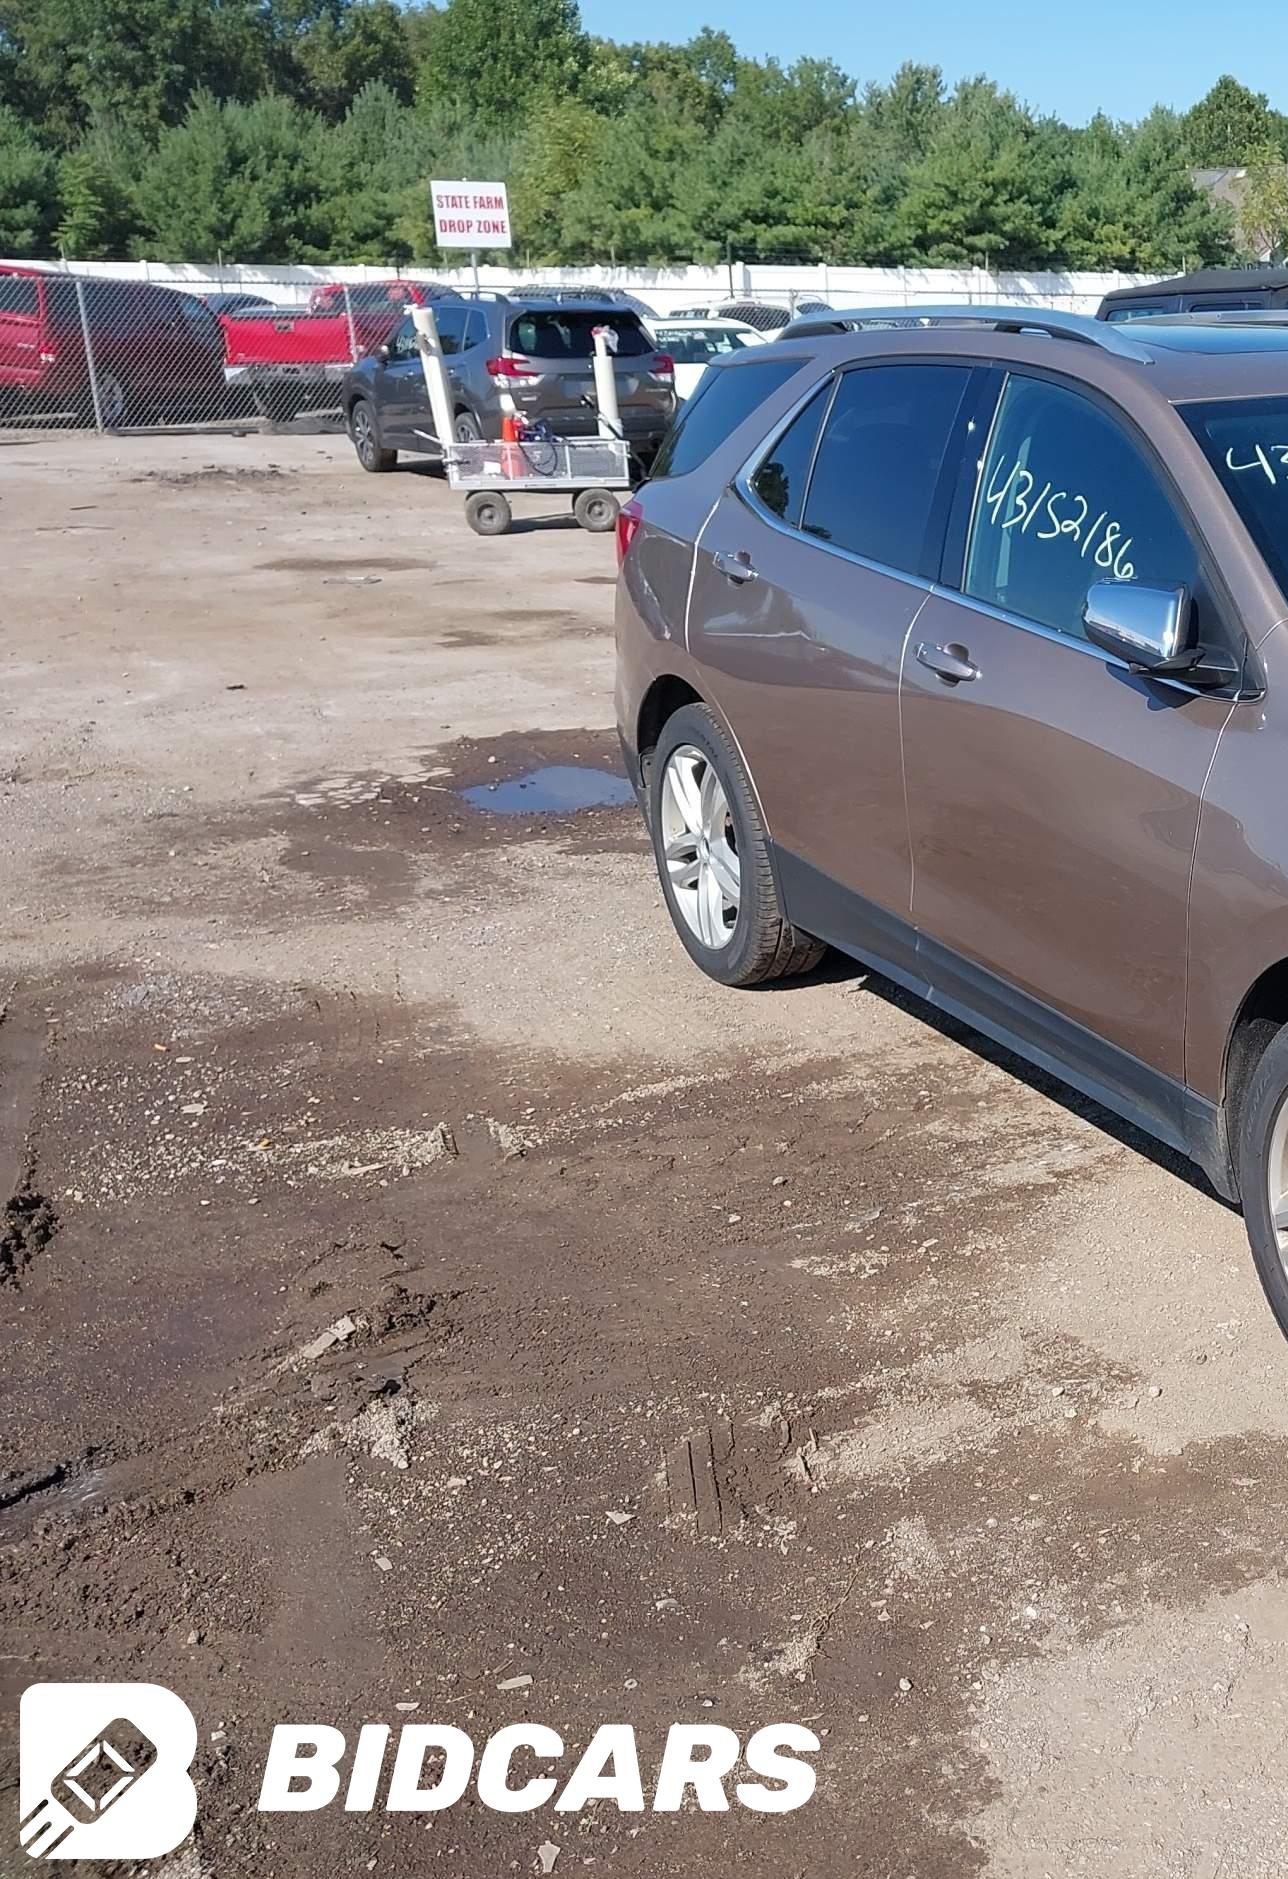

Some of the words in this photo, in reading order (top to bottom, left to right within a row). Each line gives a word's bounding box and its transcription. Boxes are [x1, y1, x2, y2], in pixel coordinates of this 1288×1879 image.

[436, 195, 470, 209] STATE
[473, 196, 504, 209] FARM
[439, 220, 473, 233] DROP
[477, 220, 507, 233] ZONE
[986, 453, 1135, 579] 43152186
